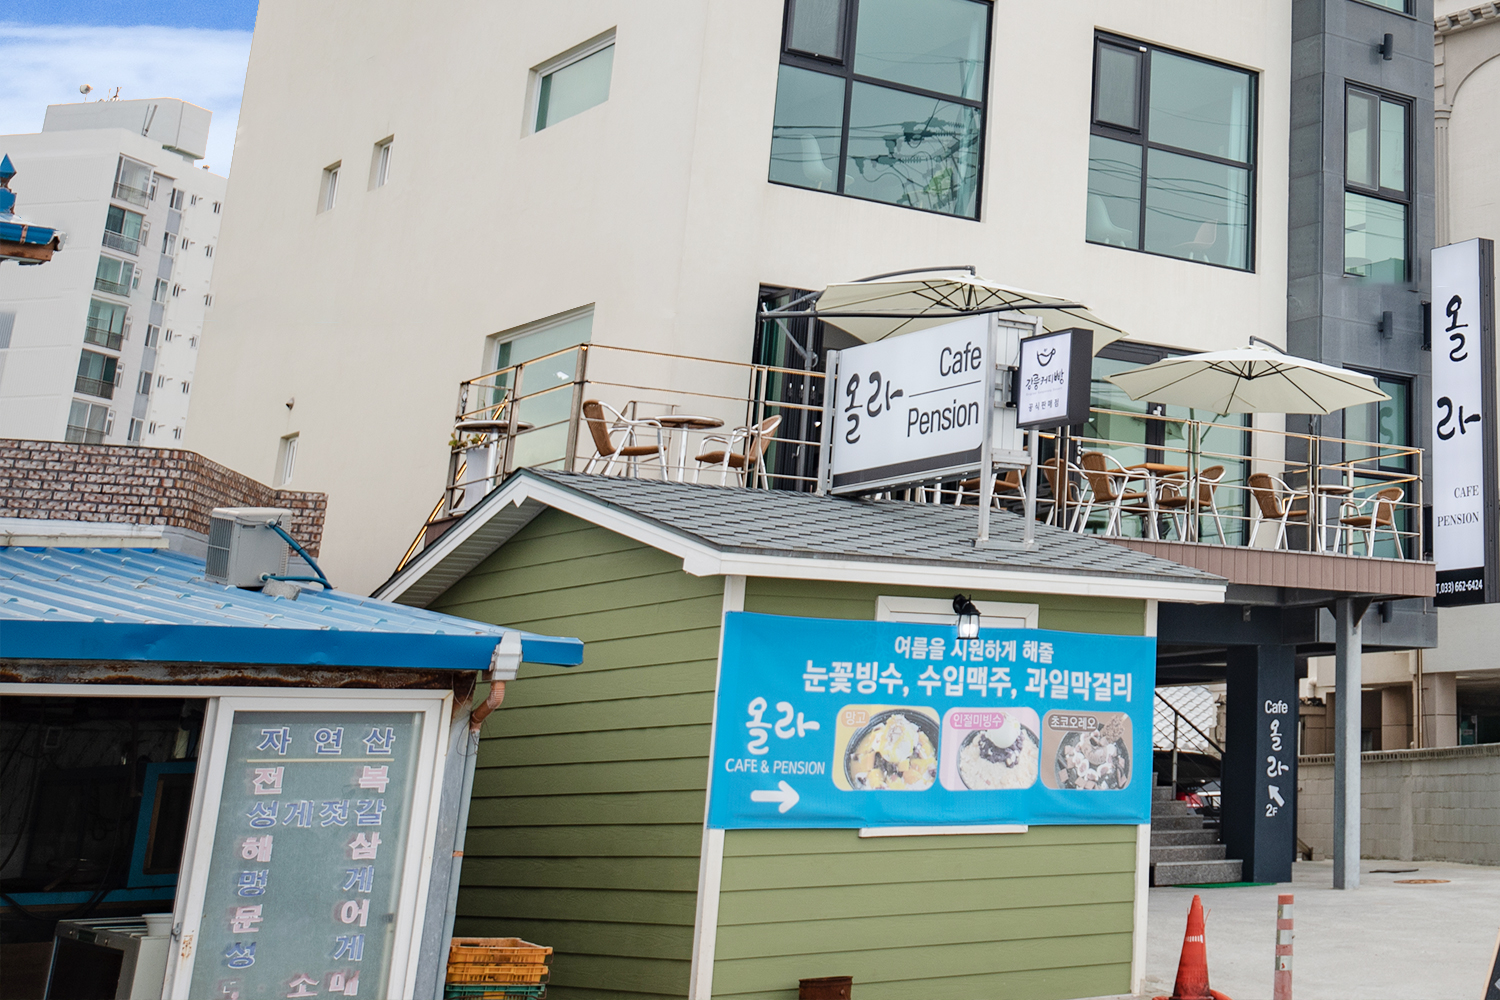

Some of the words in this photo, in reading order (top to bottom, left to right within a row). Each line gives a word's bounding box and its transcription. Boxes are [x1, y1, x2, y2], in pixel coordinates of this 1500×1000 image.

[939, 341, 982, 377] Cafe
[907, 399, 979, 438] Pension
[1453, 485, 1480, 499] CAFE
[1437, 511, 1480, 528] PENSION
[1455, 579, 1483, 592] 662-6424
[894, 635, 946, 661] 여름을
[950, 638, 1017, 663] 시원하게
[1022, 640, 1055, 665] 해줄
[802, 659, 910, 698] 눈꽃빙수,
[917, 664, 1017, 700] 수입맥주,
[1024, 667, 1133, 702] 과일막걸리
[1265, 700, 1288, 714] Cafe
[746, 696, 820, 755] 올라
[844, 710, 868, 726] 망고
[953, 713, 1003, 730] 인절미빙수
[1050, 715, 1097, 731] 초코오레오
[257, 727, 396, 755] 자연산
[725, 758, 758, 774] CAFE
[760, 760, 770, 774] &
[773, 760, 825, 776] PENSION
[1265, 804, 1278, 817] 2F
